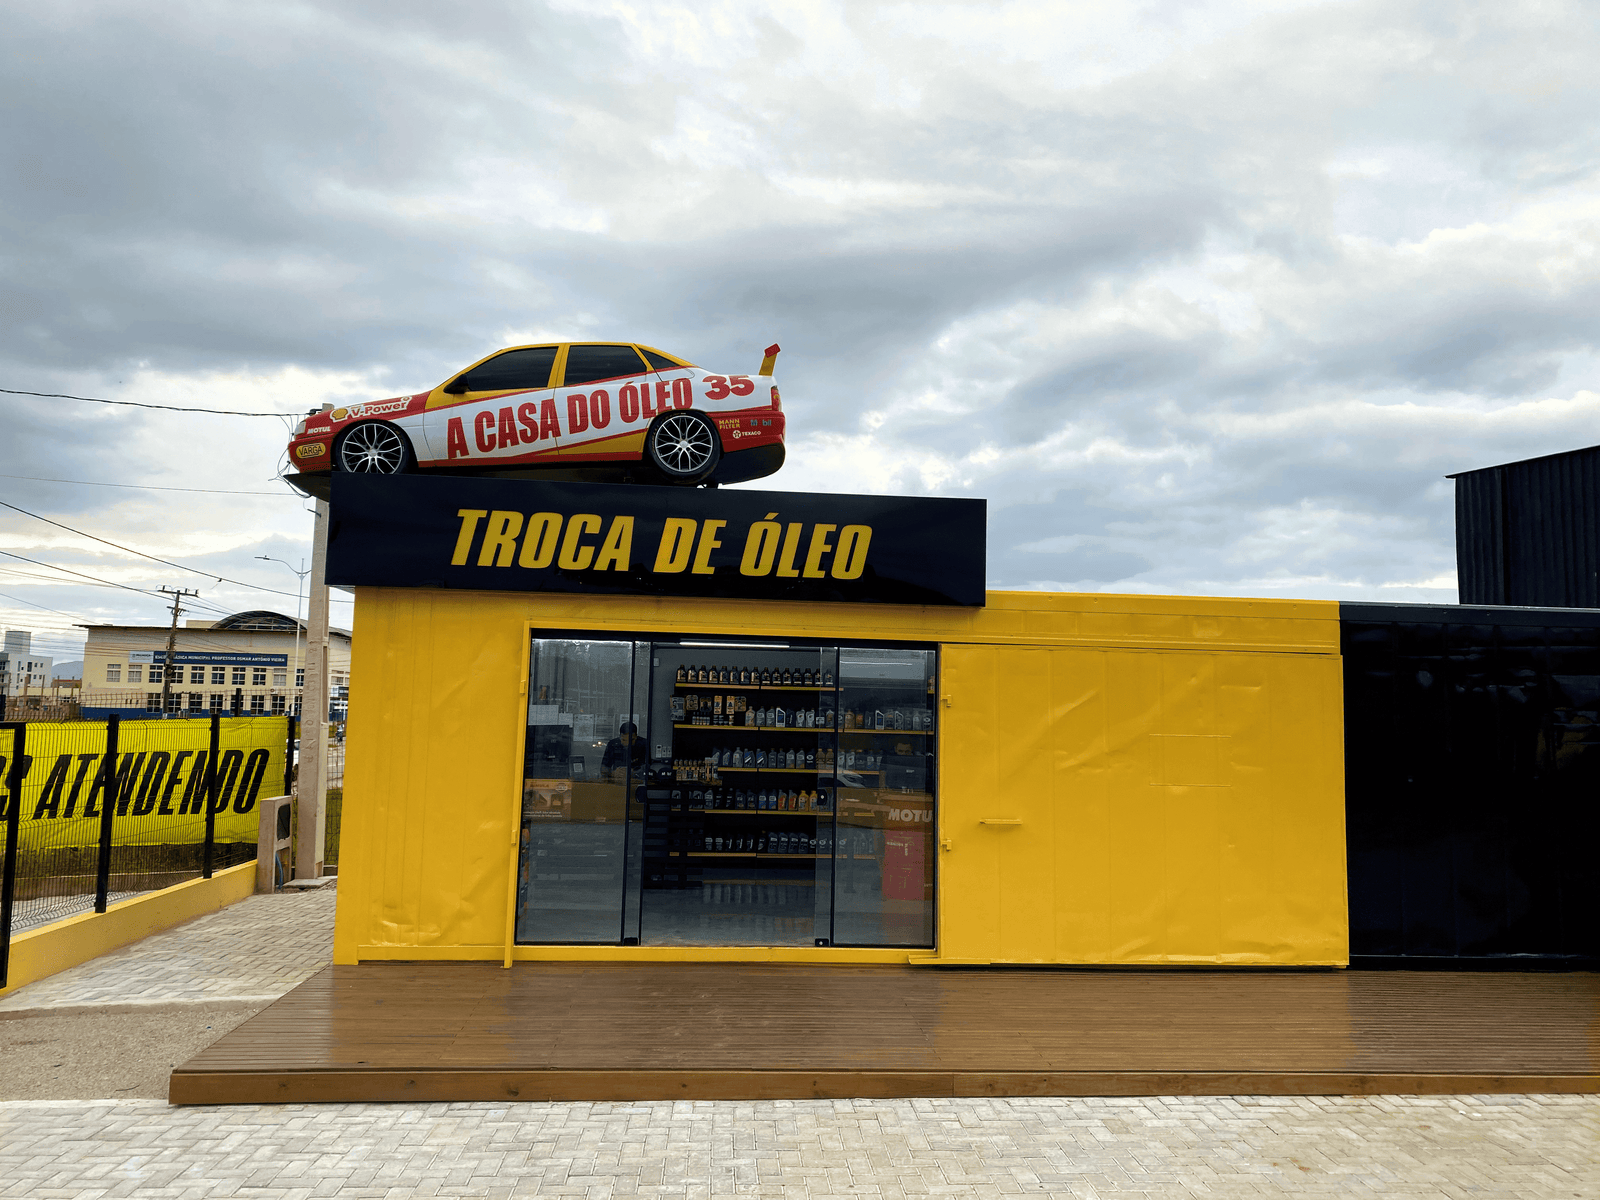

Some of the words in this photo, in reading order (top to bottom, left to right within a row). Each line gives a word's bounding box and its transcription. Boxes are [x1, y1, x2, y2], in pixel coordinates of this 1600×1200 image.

[702, 375, 755, 400] 35
[350, 402, 407, 417] V-Power
[447, 416, 470, 459] A
[474, 398, 562, 453] CASA
[566, 389, 611, 435] DO
[618, 377, 693, 424] ÓLEO
[307, 426, 331, 434] MOTUL
[298, 445, 323, 456] VARGA
[450, 508, 635, 572] TROCA
[653, 517, 727, 575] DE
[739, 512, 873, 580] ÓLEO
[33, 748, 270, 819] ATENDENDO
[888, 808, 933, 822] MOTU
